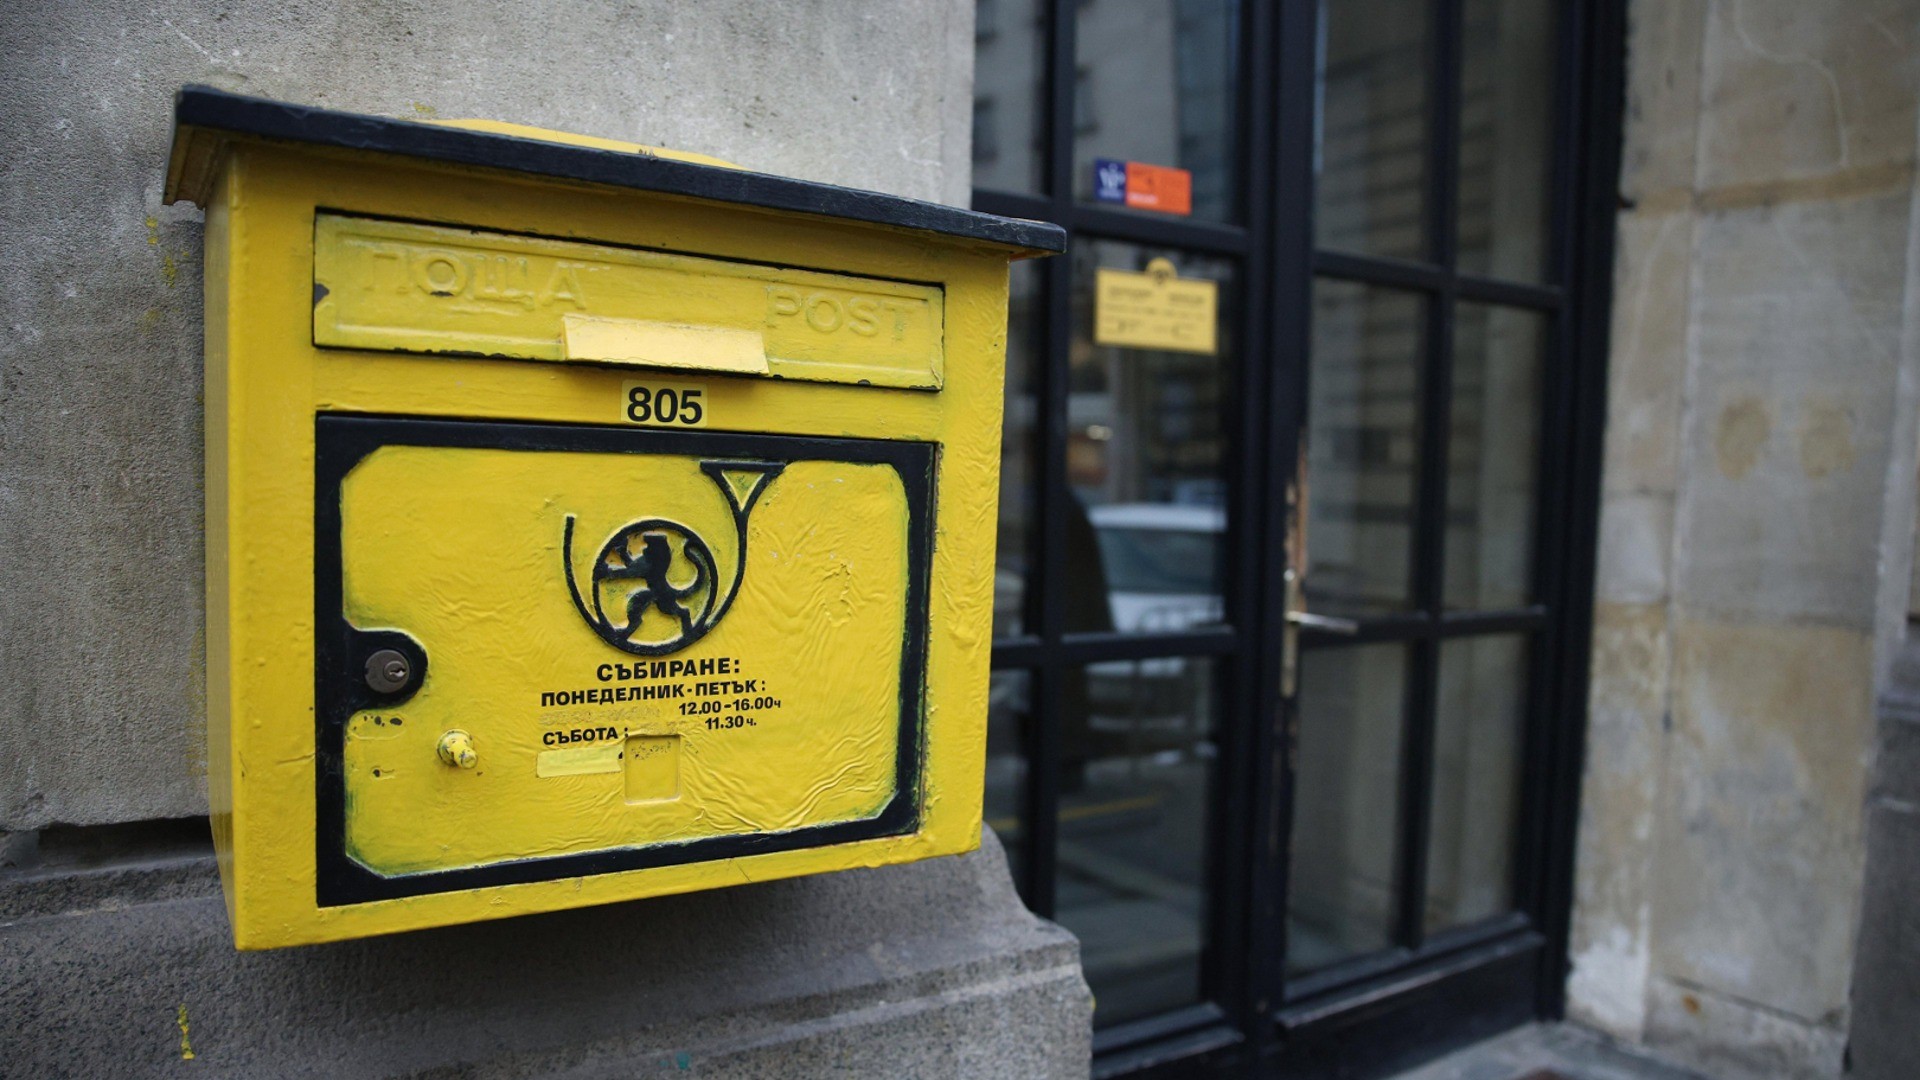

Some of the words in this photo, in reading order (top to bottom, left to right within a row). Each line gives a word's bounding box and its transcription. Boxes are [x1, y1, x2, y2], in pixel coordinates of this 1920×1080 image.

[362, 248, 587, 311] ПОЩА
[765, 284, 916, 342] POST
[627, 385, 704, 425] 805
